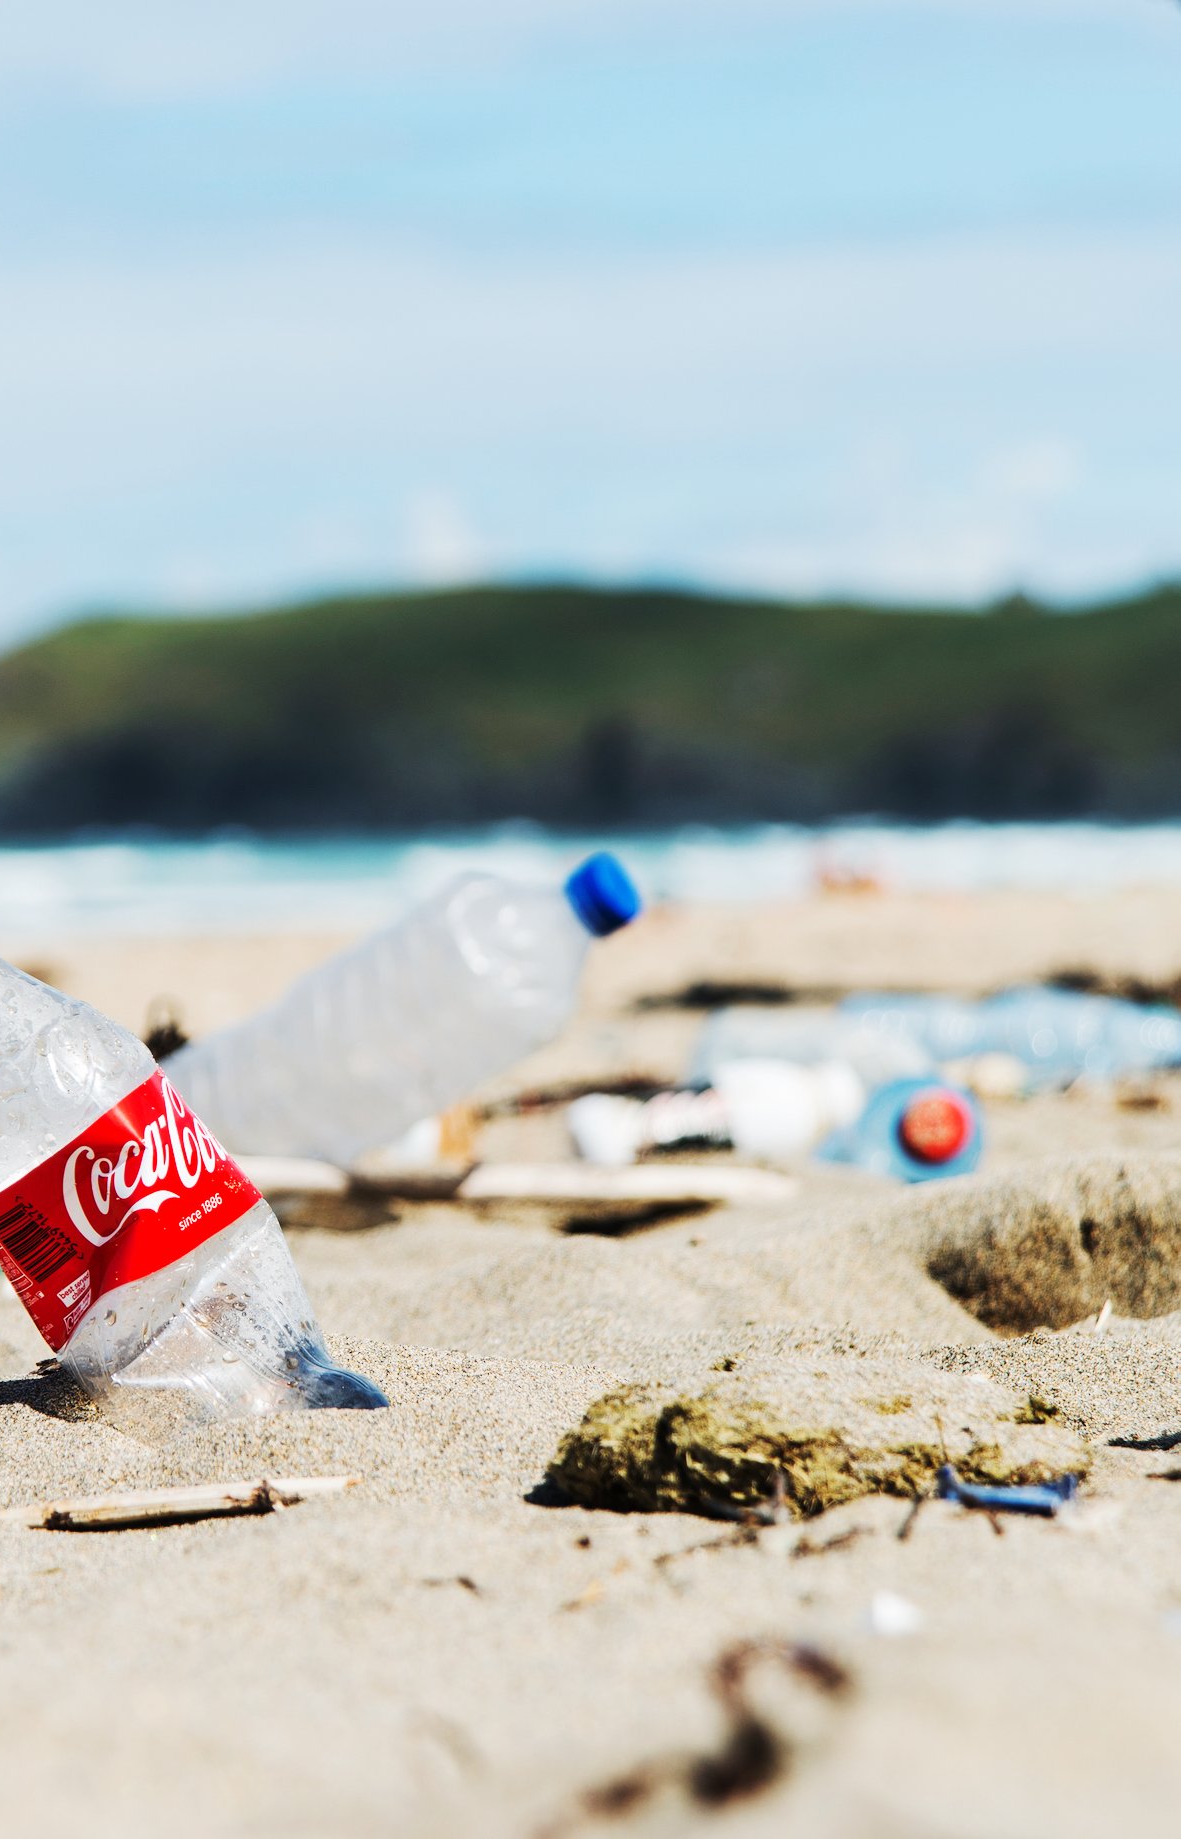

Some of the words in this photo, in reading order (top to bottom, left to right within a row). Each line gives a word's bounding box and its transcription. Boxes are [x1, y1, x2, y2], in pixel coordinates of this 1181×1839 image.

[179, 1209, 202, 1231] since
[201, 1192, 223, 1215] 1886
[59, 1285, 75, 1300] best
